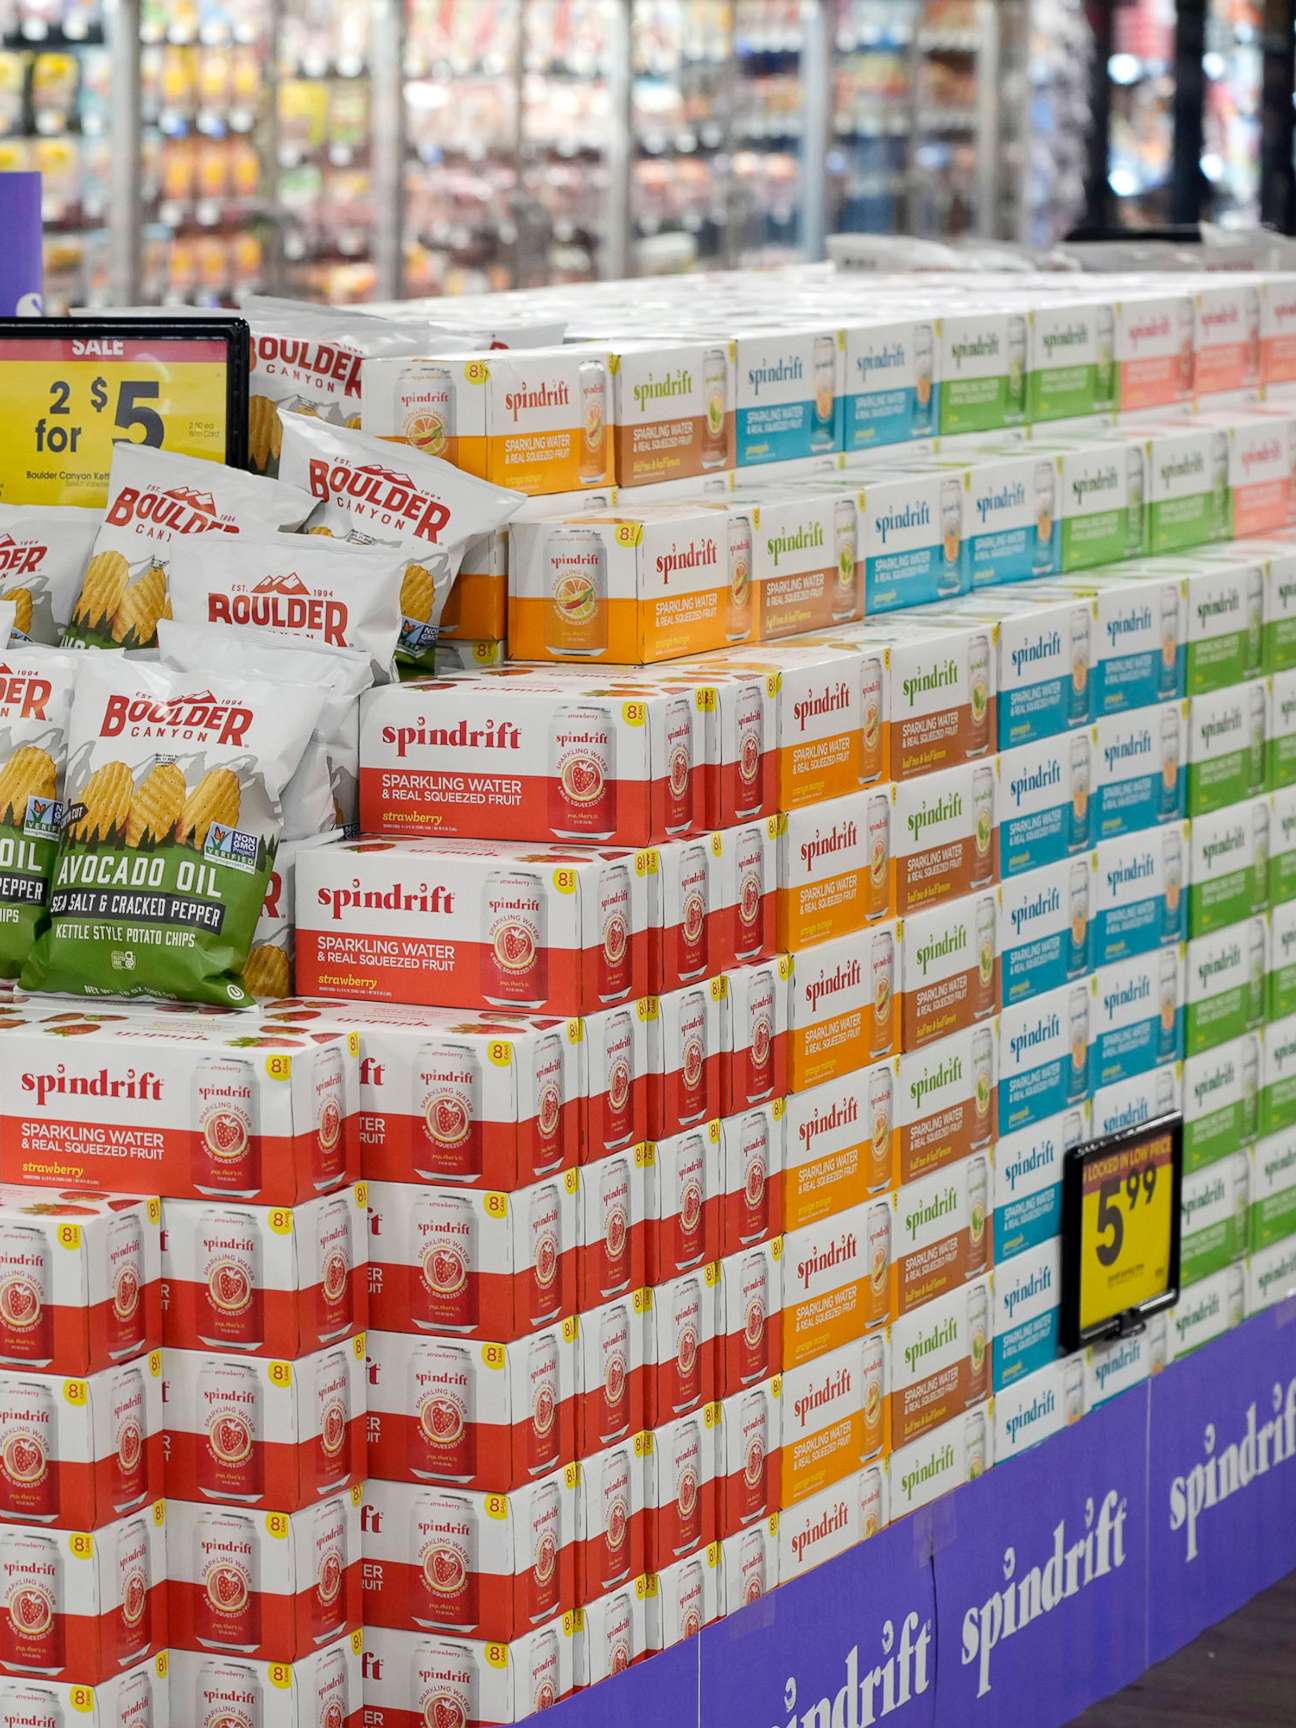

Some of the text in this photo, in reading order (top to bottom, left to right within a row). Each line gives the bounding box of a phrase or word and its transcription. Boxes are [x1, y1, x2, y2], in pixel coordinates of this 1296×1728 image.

[72, 340, 124, 356] SALE
[951, 332, 1000, 367] spindrift
[266, 364, 334, 392] CANYON
[633, 369, 692, 401] spindrift
[748, 357, 803, 398] spindrift
[50, 381, 70, 414] 2
[505, 382, 568, 422] spindrift
[35, 418, 82, 452] for
[505, 434, 571, 451] SPARKLING WATER
[26, 471, 110, 481] Boulder Canyon Kett
[1072, 470, 1118, 501] spindrift
[309, 457, 451, 544] BOULDER
[336, 496, 405, 531] CANYON
[875, 504, 931, 543] spindrift
[550, 553, 600, 568] spindrift
[656, 539, 717, 584] spindrift
[767, 522, 824, 566] spindrift
[231, 584, 334, 598] EST. 1994
[208, 591, 349, 648] BOULDER
[1107, 610, 1152, 647] spindrift
[1011, 632, 1061, 676] spindrift
[902, 660, 959, 705] spindrift
[99, 694, 254, 748] BOULDER
[627, 705, 636, 720] 8
[793, 687, 850, 731] spindrift
[131, 727, 208, 742] CANYON
[382, 716, 521, 757] spindrift
[556, 731, 608, 747] spindrift
[382, 774, 522, 793] SPARKLING WATER
[382, 790, 522, 806] & REAL SQUEEZED FRUIT
[382, 811, 442, 824] strawberry
[907, 792, 963, 840] spindrift
[208, 848, 253, 864] VERIFIED
[234, 841, 255, 851] GMO
[235, 833, 255, 844] NON
[801, 821, 857, 871] spindrift
[57, 855, 222, 898] AVOCADO OIL
[51, 894, 221, 927] SEA SALT & CRACKED PEPPER
[317, 879, 454, 919] spindrift
[56, 924, 195, 947] KETTLE STYLE POTATO CHIPS
[21, 1064, 164, 1105] spindrift
[910, 1057, 963, 1108] spindrift
[799, 1099, 858, 1150] spindrift
[1005, 1142, 1055, 1191] spindrift
[1170, 1376, 1296, 1562] spindrif
[960, 1489, 1127, 1699] spindrift
[771, 1611, 931, 1728] indrift
